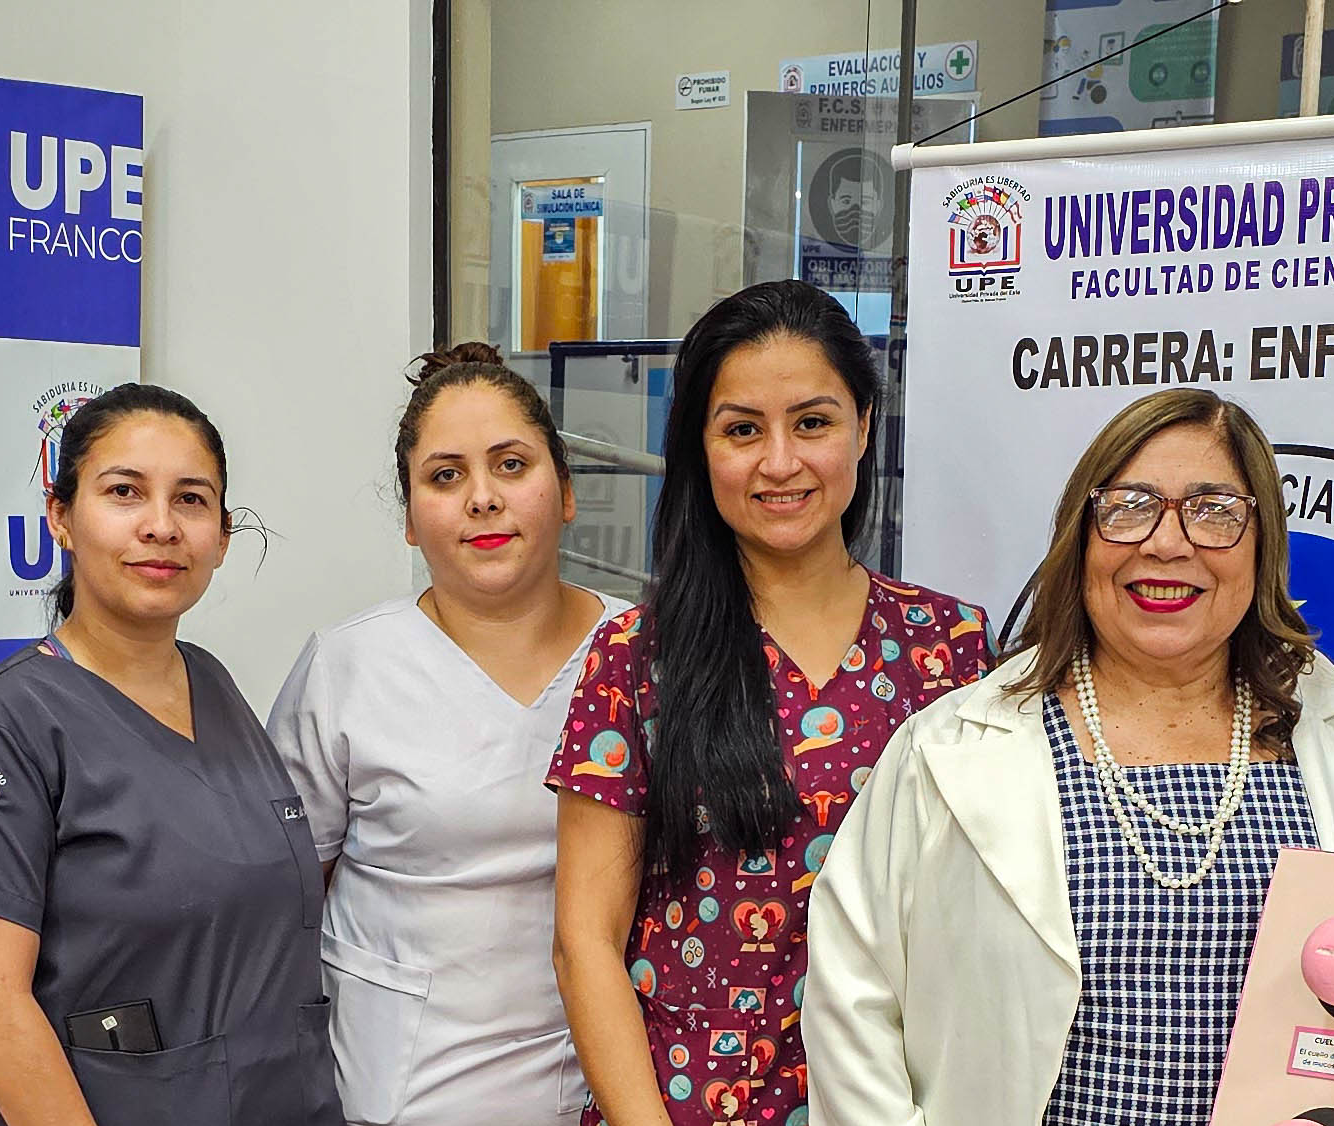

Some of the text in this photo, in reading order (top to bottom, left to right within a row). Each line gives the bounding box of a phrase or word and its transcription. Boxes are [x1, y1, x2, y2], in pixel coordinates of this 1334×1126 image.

[917, 52, 926, 66] Y
[880, 72, 945, 93] AULIOS
[10, 131, 143, 221] UPE
[942, 176, 1031, 209] SABIDURIA ES LIBERTAD
[1044, 180, 1285, 261] UNIVERSIDAD
[9, 216, 143, 264] FRANCO
[955, 275, 1015, 293] UPE
[1071, 263, 1214, 300] FACULTAD
[1225, 260, 1261, 292] DE
[1012, 329, 1234, 390] CARRERA:
[32, 381, 77, 414] SABIDURIA
[78, 381, 88, 392] ES
